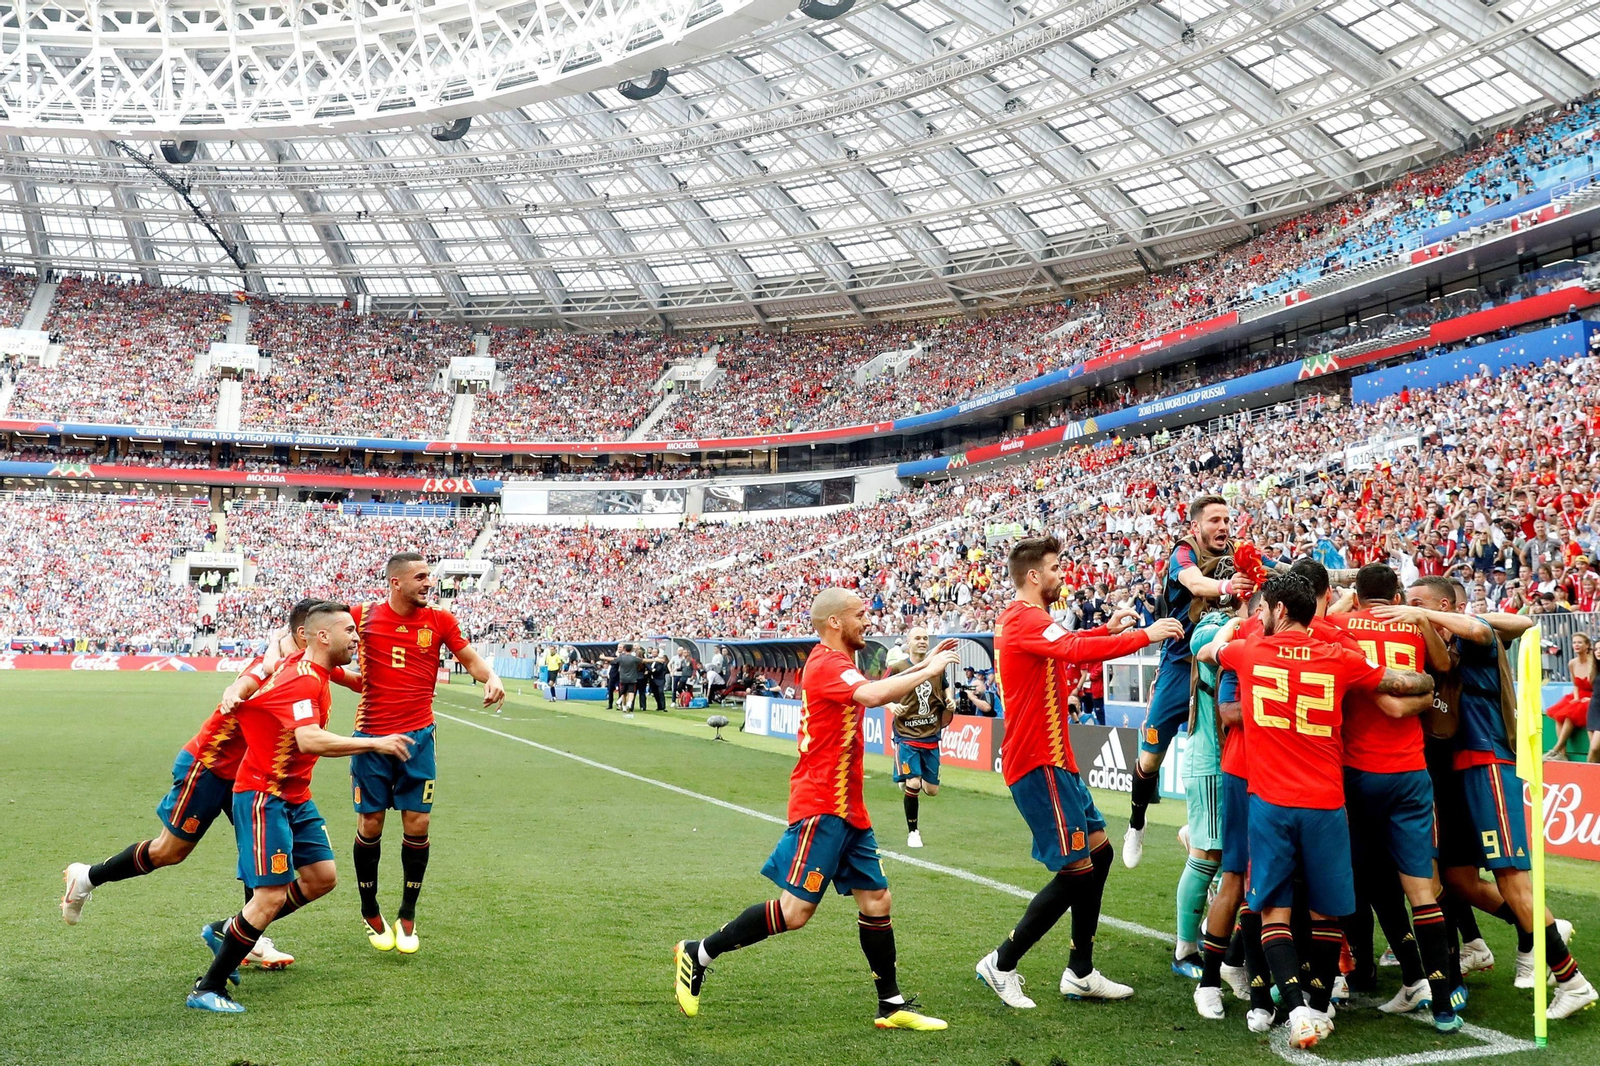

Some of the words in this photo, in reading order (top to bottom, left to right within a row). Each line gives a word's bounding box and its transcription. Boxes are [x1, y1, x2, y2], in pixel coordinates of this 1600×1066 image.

[1138, 407, 1151, 417] 2018
[1152, 402, 1165, 414] FIFA
[1165, 396, 1187, 410] WORLD
[1187, 392, 1201, 404] CUP
[1201, 386, 1226, 400] RUSSIA
[136, 428, 190, 439] ЧЕМПИОНАТ
[191, 430, 218, 440] МИРА
[218, 432, 232, 440] ПО
[233, 433, 273, 443] ФУТБОЛУ
[322, 438, 358, 446] РОССИИ
[666, 441, 699, 450] МОСКВА
[246, 474, 287, 483] МОСКВА
[1347, 617, 1385, 632] DIEGO
[391, 646, 406, 668] 8
[1276, 646, 1311, 661] ISCO
[1252, 665, 1335, 738] 22
[1432, 697, 1449, 713] 018
[904, 719, 929, 727] RUSSIA
[1088, 764, 1133, 793] adidas
[422, 780, 436, 804] 8
[1481, 830, 1502, 860] 9
